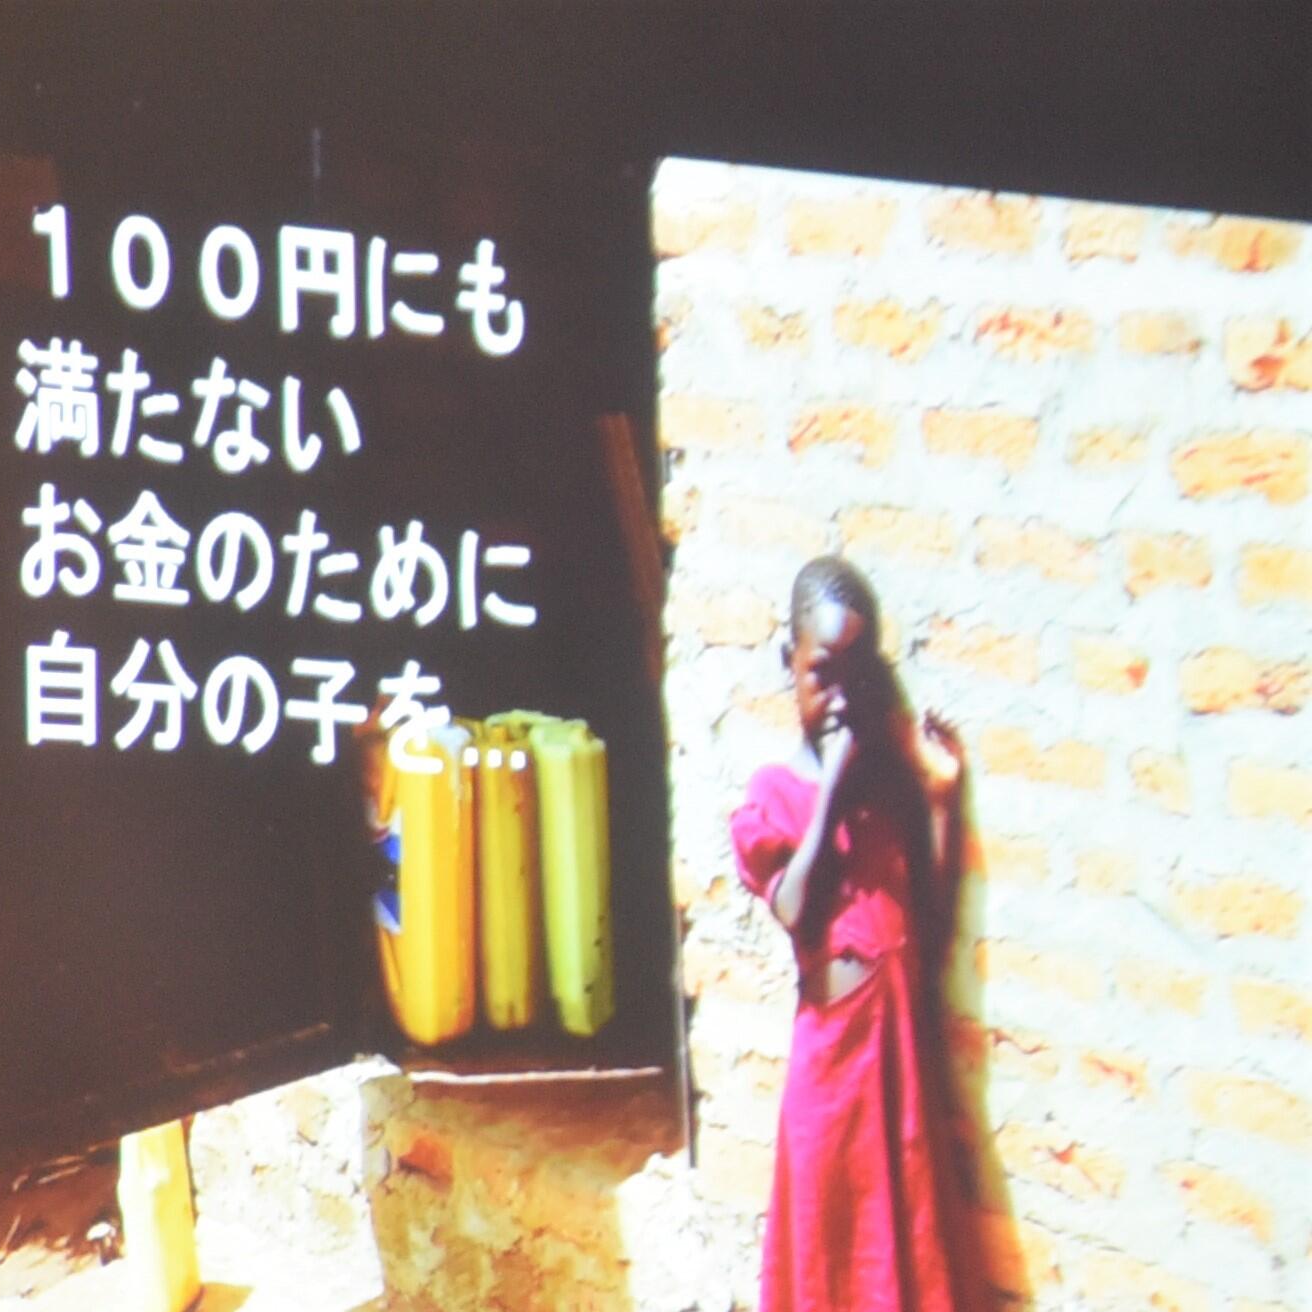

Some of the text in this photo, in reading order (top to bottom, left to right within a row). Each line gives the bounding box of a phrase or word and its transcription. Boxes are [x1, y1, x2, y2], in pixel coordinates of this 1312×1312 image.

[14, 336, 362, 473] 満たない
[20, 482, 537, 629] お金のために
